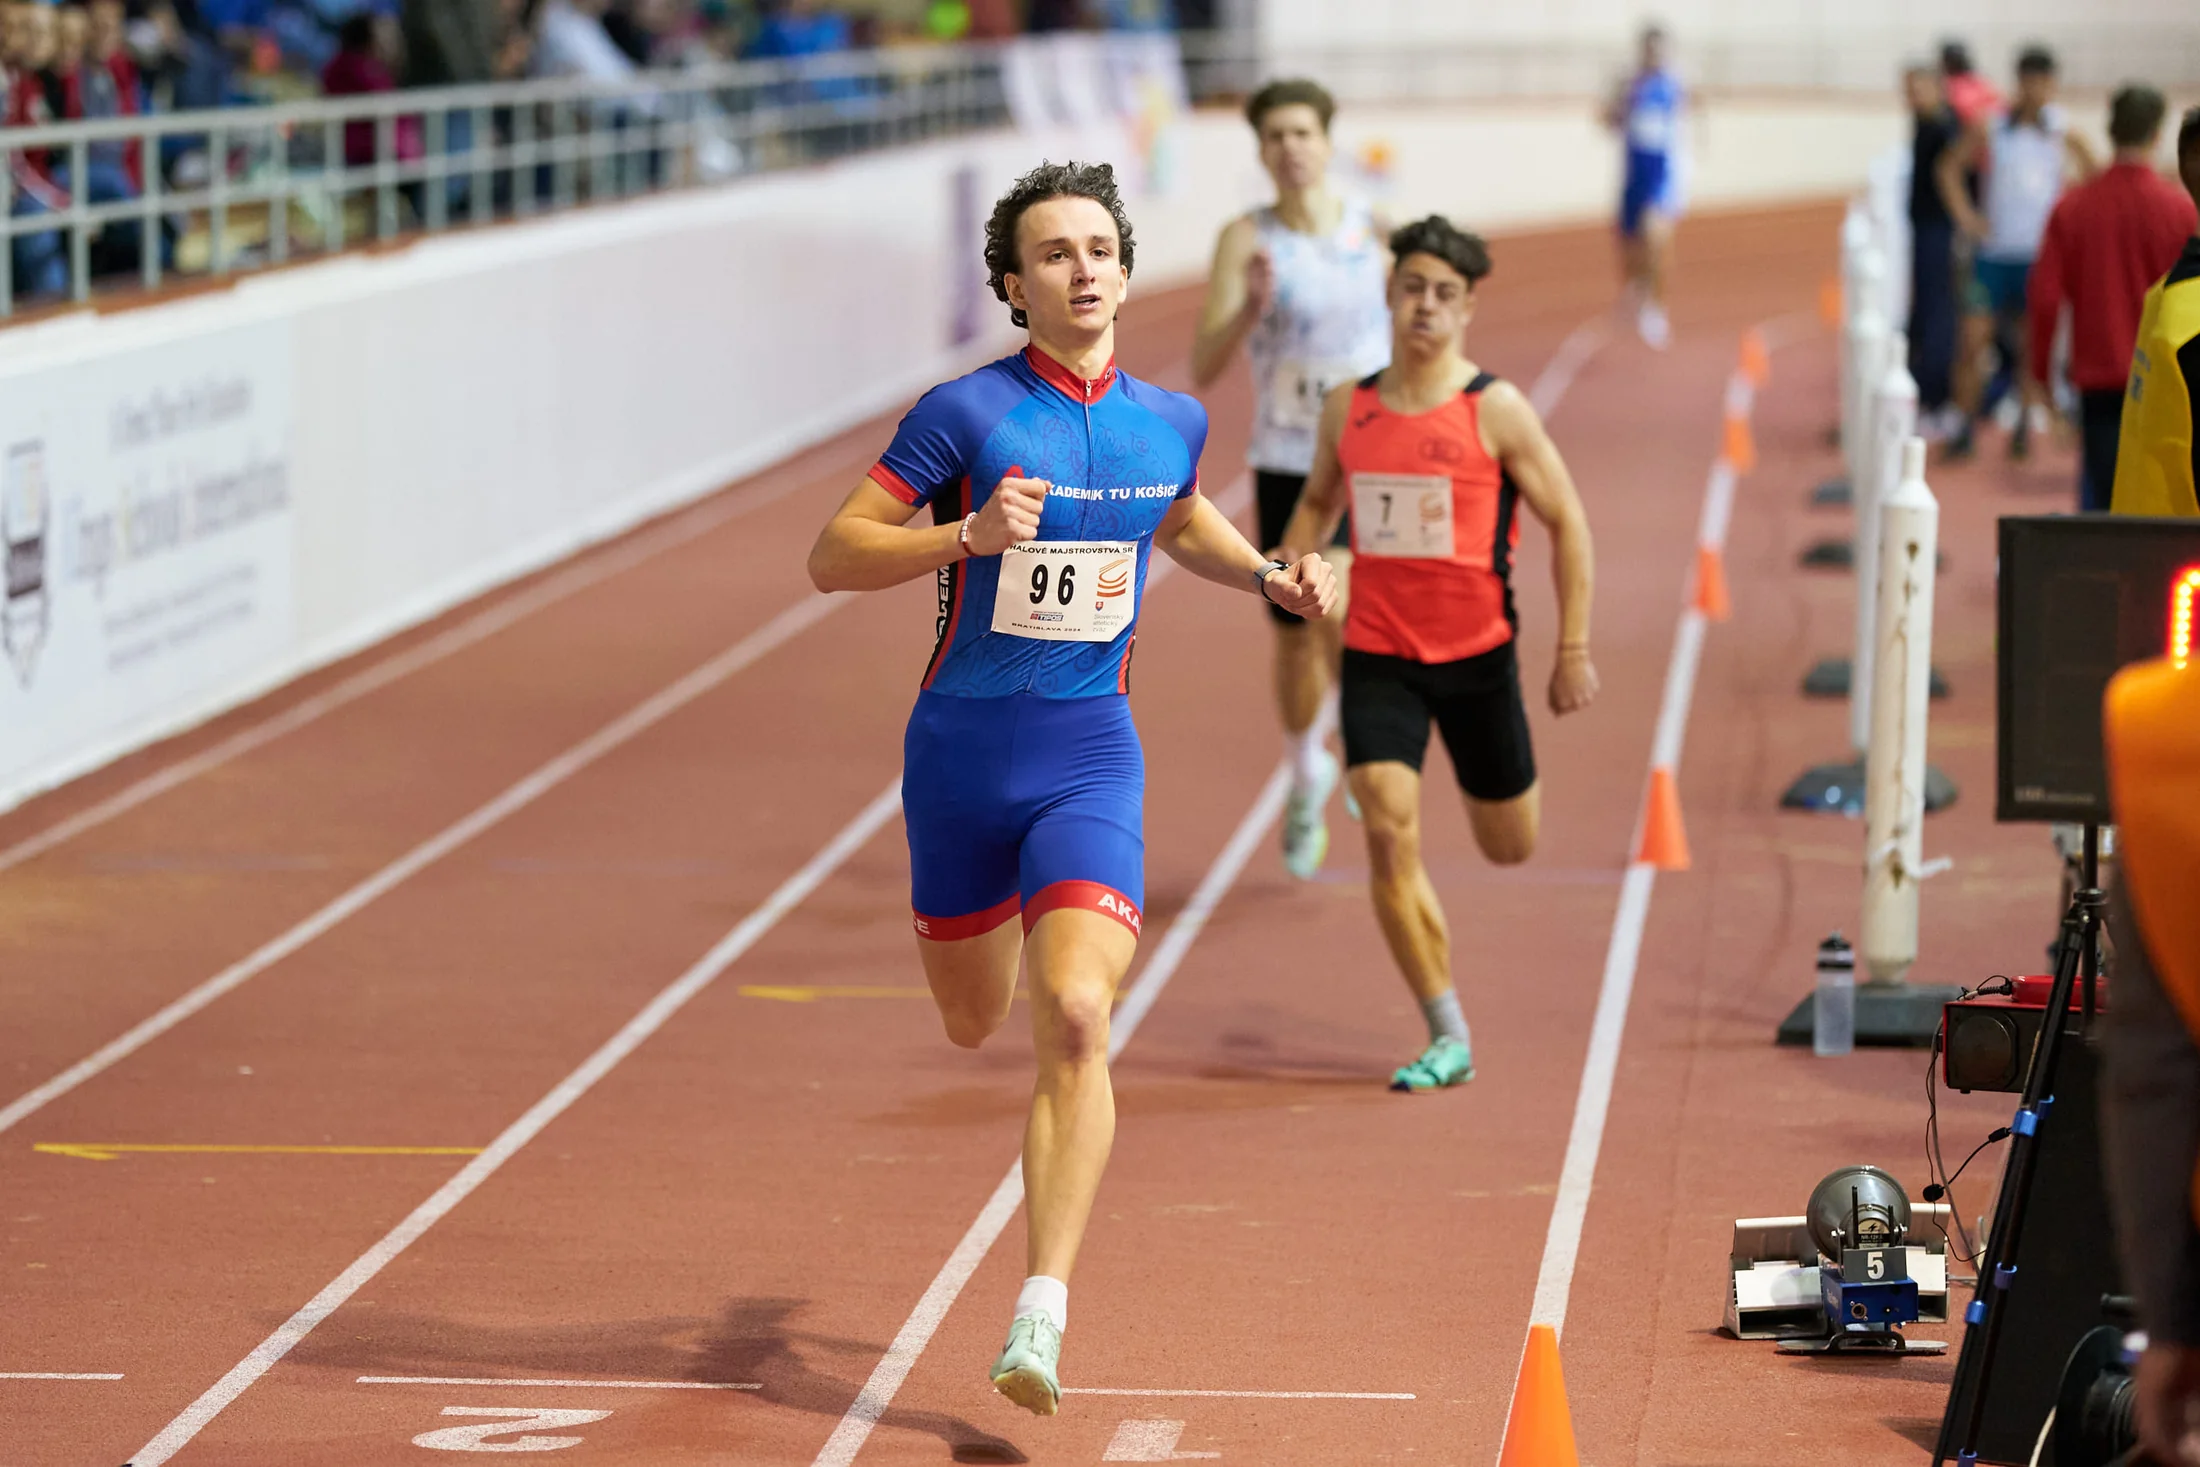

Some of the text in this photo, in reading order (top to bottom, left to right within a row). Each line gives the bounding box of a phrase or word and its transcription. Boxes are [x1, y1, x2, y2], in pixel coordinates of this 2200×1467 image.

[1045, 483, 1179, 501] KADEMIK TU KOŠICE
[1379, 493, 1392, 526] 7
[1009, 544, 1134, 555] HALOVÉ MAJSTROVSTVÁ SR
[1029, 564, 1076, 606] 96
[1011, 622, 1062, 632] BRATISLAVA
[913, 918, 930, 935] E
[1097, 893, 1142, 938] AKA
[1867, 1251, 1885, 1280] 5
[411, 1406, 614, 1452] 2
